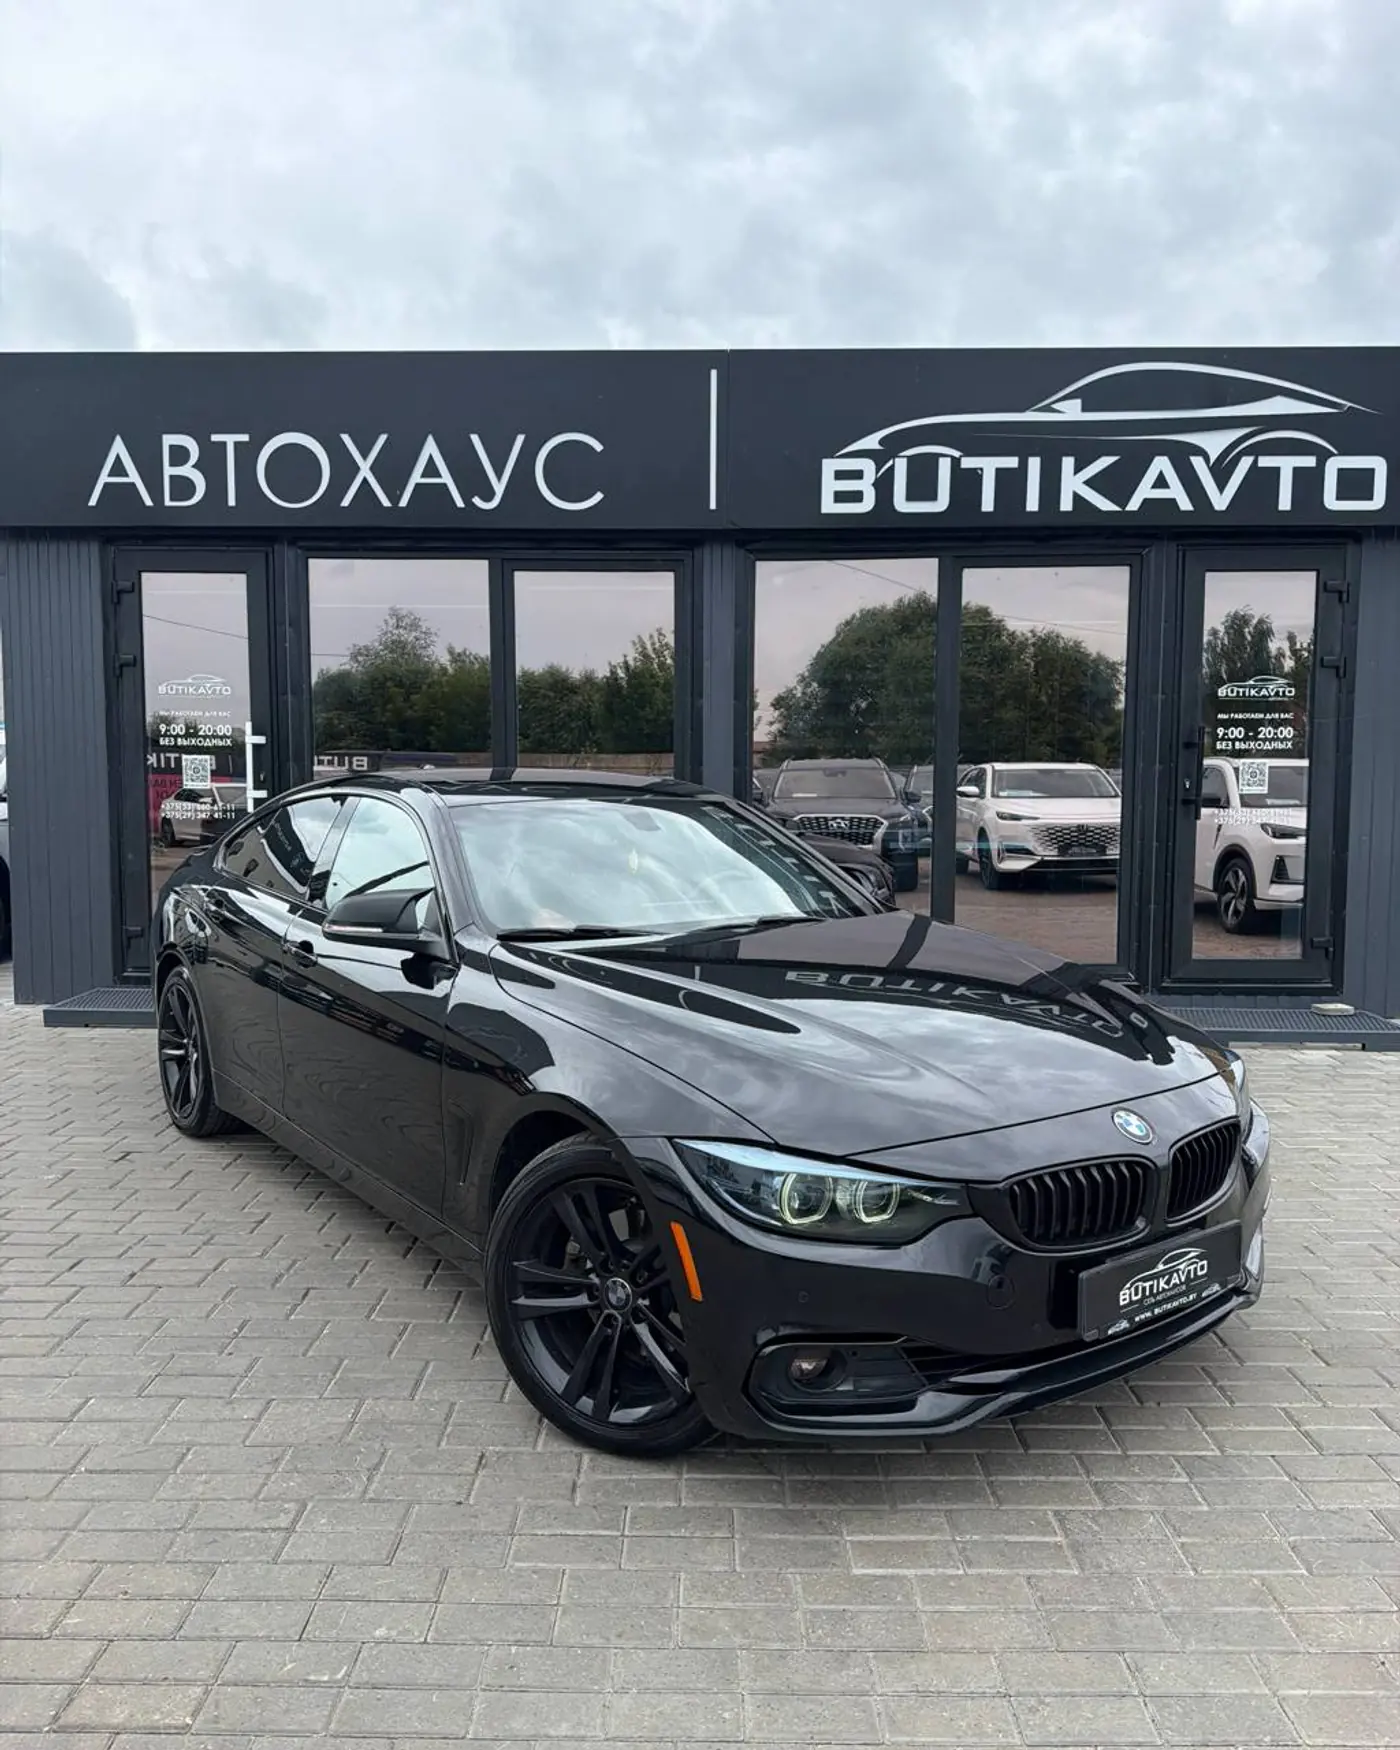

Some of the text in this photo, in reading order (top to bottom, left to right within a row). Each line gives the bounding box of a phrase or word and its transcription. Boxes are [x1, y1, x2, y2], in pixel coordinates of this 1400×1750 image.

[88, 432, 604, 511] АВТОХАУС
[820, 454, 1388, 514] BUTIKAVTO
[158, 685, 231, 695] BUTIKAVTO
[1217, 686, 1296, 697] BUTIKAVTO
[159, 724, 186, 735] 9:00
[198, 724, 233, 736] 20:00
[1216, 727, 1245, 739] 9:00
[1257, 726, 1294, 739] 20:00
[159, 737, 233, 747] БЕЗ ВЫХОДНЫХ
[1216, 740, 1293, 750] БЕЗ ВЫХОДНЫХ
[1119, 1260, 1208, 1306] BUTIKAVTO
